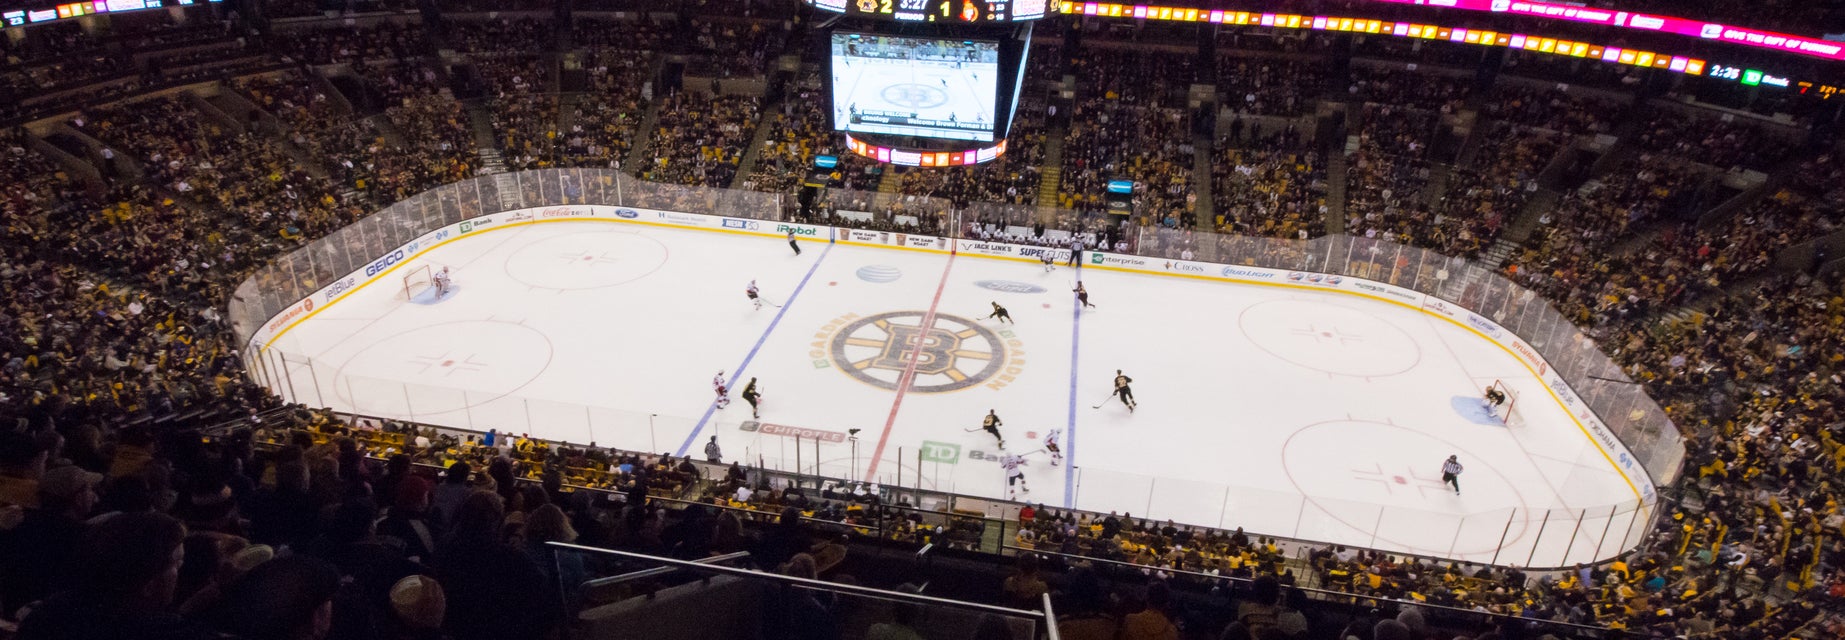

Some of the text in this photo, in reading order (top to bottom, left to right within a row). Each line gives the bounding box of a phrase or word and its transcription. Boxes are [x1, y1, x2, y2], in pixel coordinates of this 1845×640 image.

[880, 0, 893, 13] 2
[940, 1, 950, 17] 1
[894, 12, 925, 20] PERIOD
[1724, 30, 1746, 40] GIVE
[1746, 33, 1764, 44] THE
[1764, 36, 1786, 46] GIFT
[1785, 39, 1800, 49] OF
[1710, 64, 1740, 80] 2:35
[908, 118, 934, 126] Welcome
[617, 209, 636, 218] Ford
[474, 218, 492, 227] Bank
[777, 224, 817, 236] iRobot
[366, 250, 404, 277] GEICO
[325, 277, 355, 302] jetBlue
[985, 282, 1034, 293] Ford
[873, 326, 960, 374] B
[1512, 341, 1540, 367] SYLVANIA
[762, 424, 841, 443] CHIPOTLE
[925, 442, 1005, 463] TD Ba
